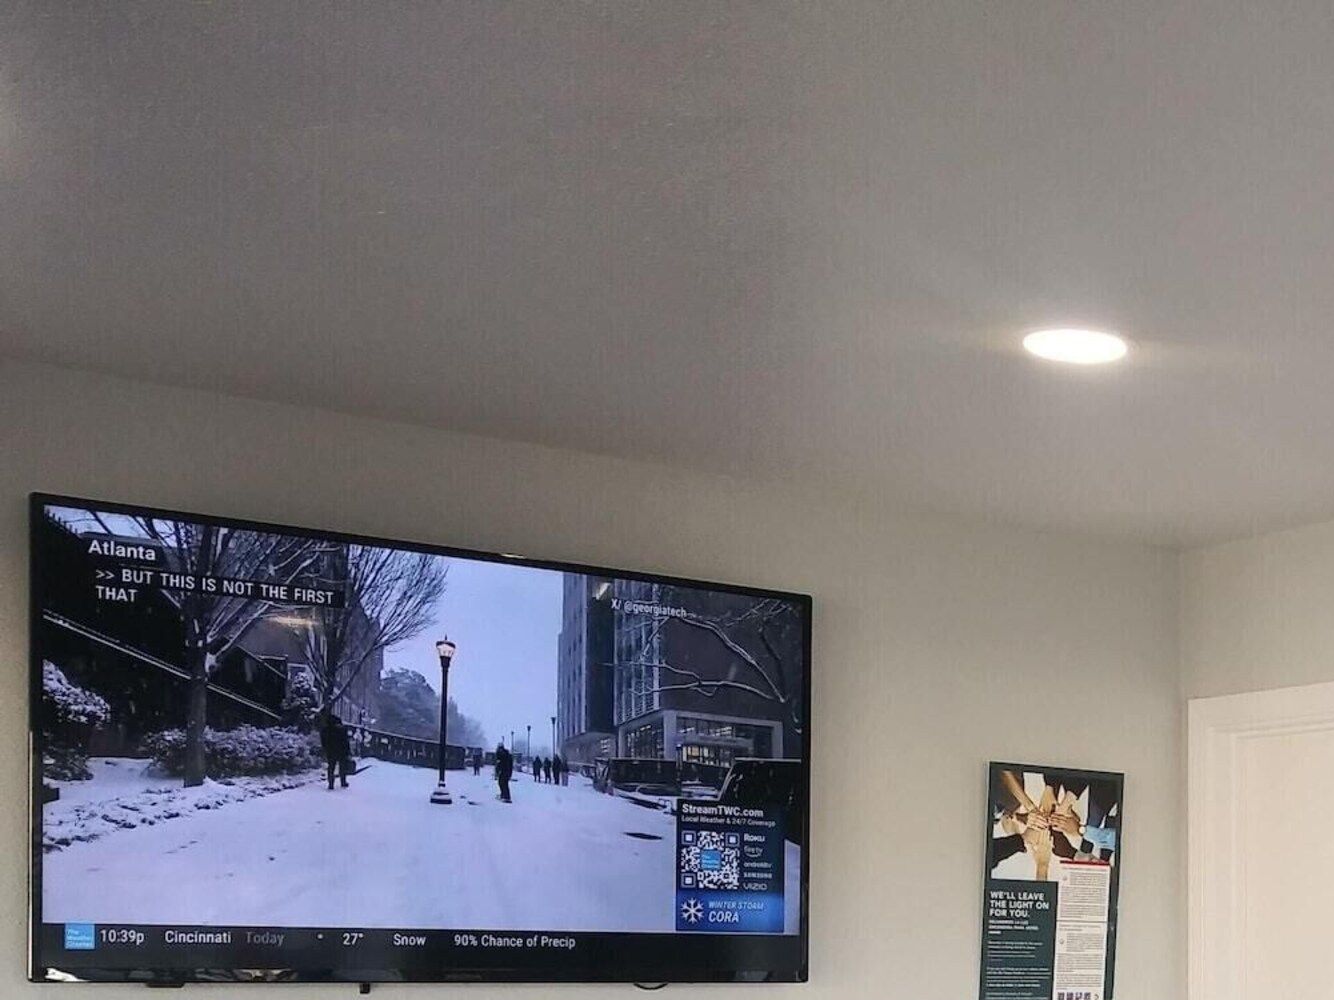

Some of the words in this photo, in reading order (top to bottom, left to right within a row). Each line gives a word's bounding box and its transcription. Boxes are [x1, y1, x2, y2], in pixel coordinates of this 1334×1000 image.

[88, 540, 156, 561] Atlanta
[122, 569, 152, 584] BUT
[160, 573, 195, 589] THIS
[202, 577, 216, 592] IS
[223, 580, 253, 595] NOT
[260, 584, 287, 600] THE
[294, 588, 334, 604] FIRST
[95, 586, 139, 602] THAT
[624, 601, 687, 617] @georgiatech
[682, 804, 764, 818] StreamTWC.com
[990, 891, 1016, 900] WE'LL
[1018, 891, 1045, 901] LEAVE
[708, 901, 736, 910] WINTER
[738, 901, 764, 910] STORM
[990, 900, 1008, 908] THE
[1009, 901, 1034, 909] LIGHT
[1035, 902, 1050, 910] ON
[708, 911, 740, 923] CORA
[989, 908, 1008, 917] FOR
[1009, 909, 1031, 918] YOU.
[100, 929, 145, 946] 10:39p
[165, 930, 232, 944] Cincinnati
[246, 932, 285, 946] Today
[393, 933, 426, 946] Snow
[454, 934, 478, 946] 90%
[481, 935, 523, 948] Chance
[526, 935, 538, 948] of
[541, 936, 576, 950] Precip
